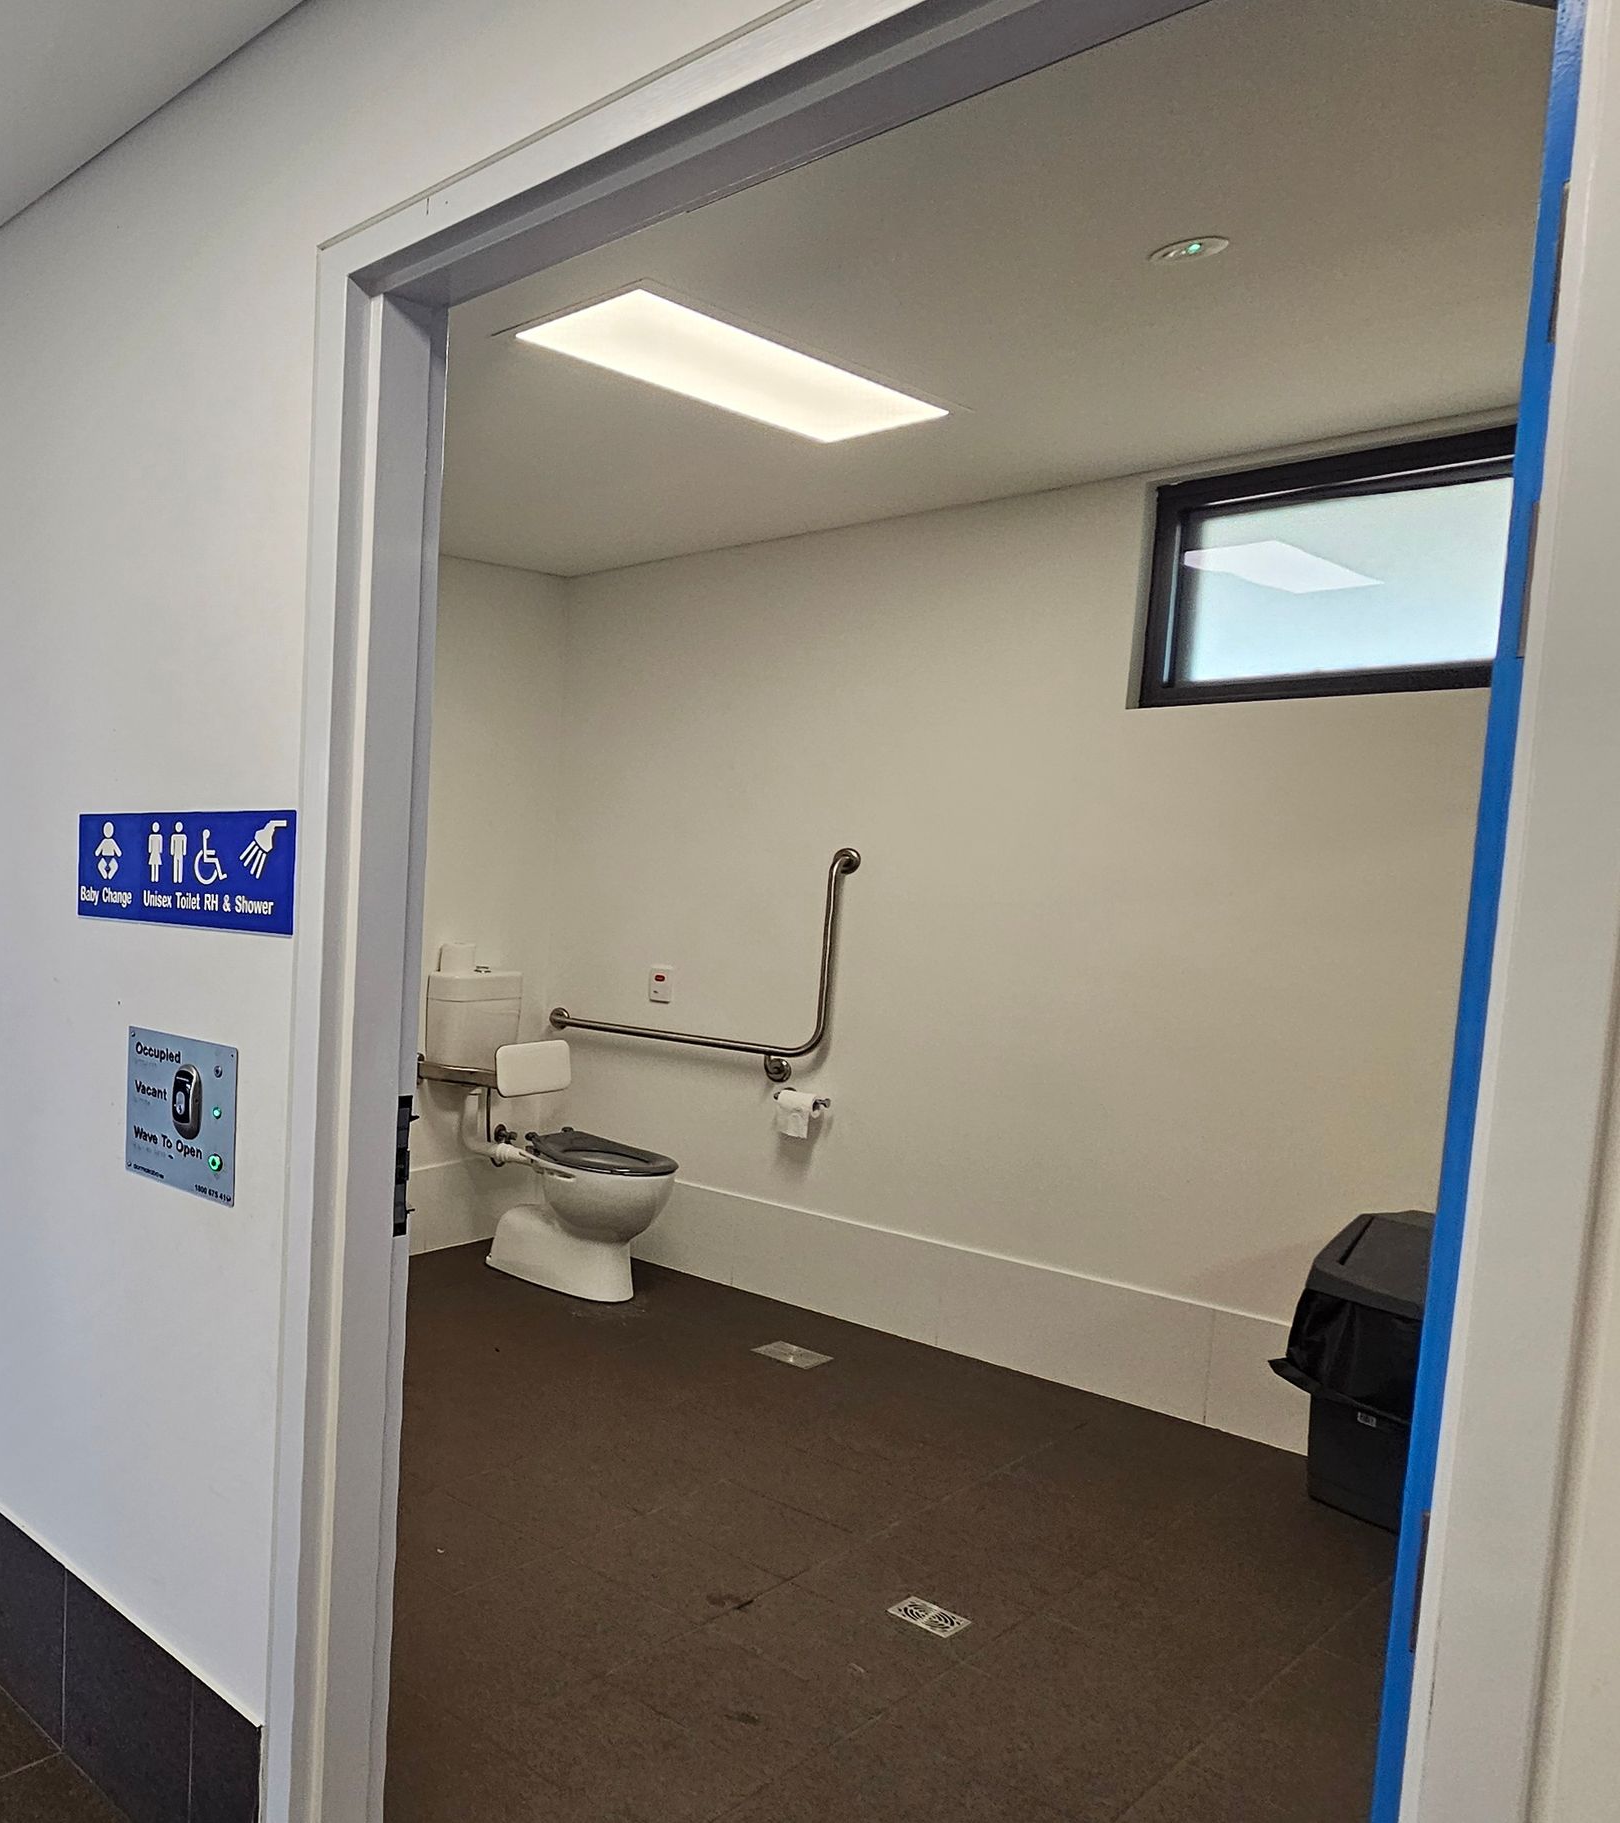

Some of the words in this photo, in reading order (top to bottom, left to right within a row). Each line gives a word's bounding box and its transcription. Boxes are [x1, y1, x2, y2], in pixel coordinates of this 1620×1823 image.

[80, 886, 99, 906] Baby
[102, 887, 132, 908] Change
[143, 890, 172, 909] Unisex
[175, 891, 201, 910] Toilet
[204, 893, 219, 912] RH
[222, 896, 231, 912] &
[235, 896, 274, 915] Shower
[135, 1041, 181, 1064] Occupied
[135, 1080, 167, 1101] Vacant
[134, 1125, 158, 1144] Wave
[161, 1134, 172, 1149] To
[176, 1139, 202, 1160] Open
